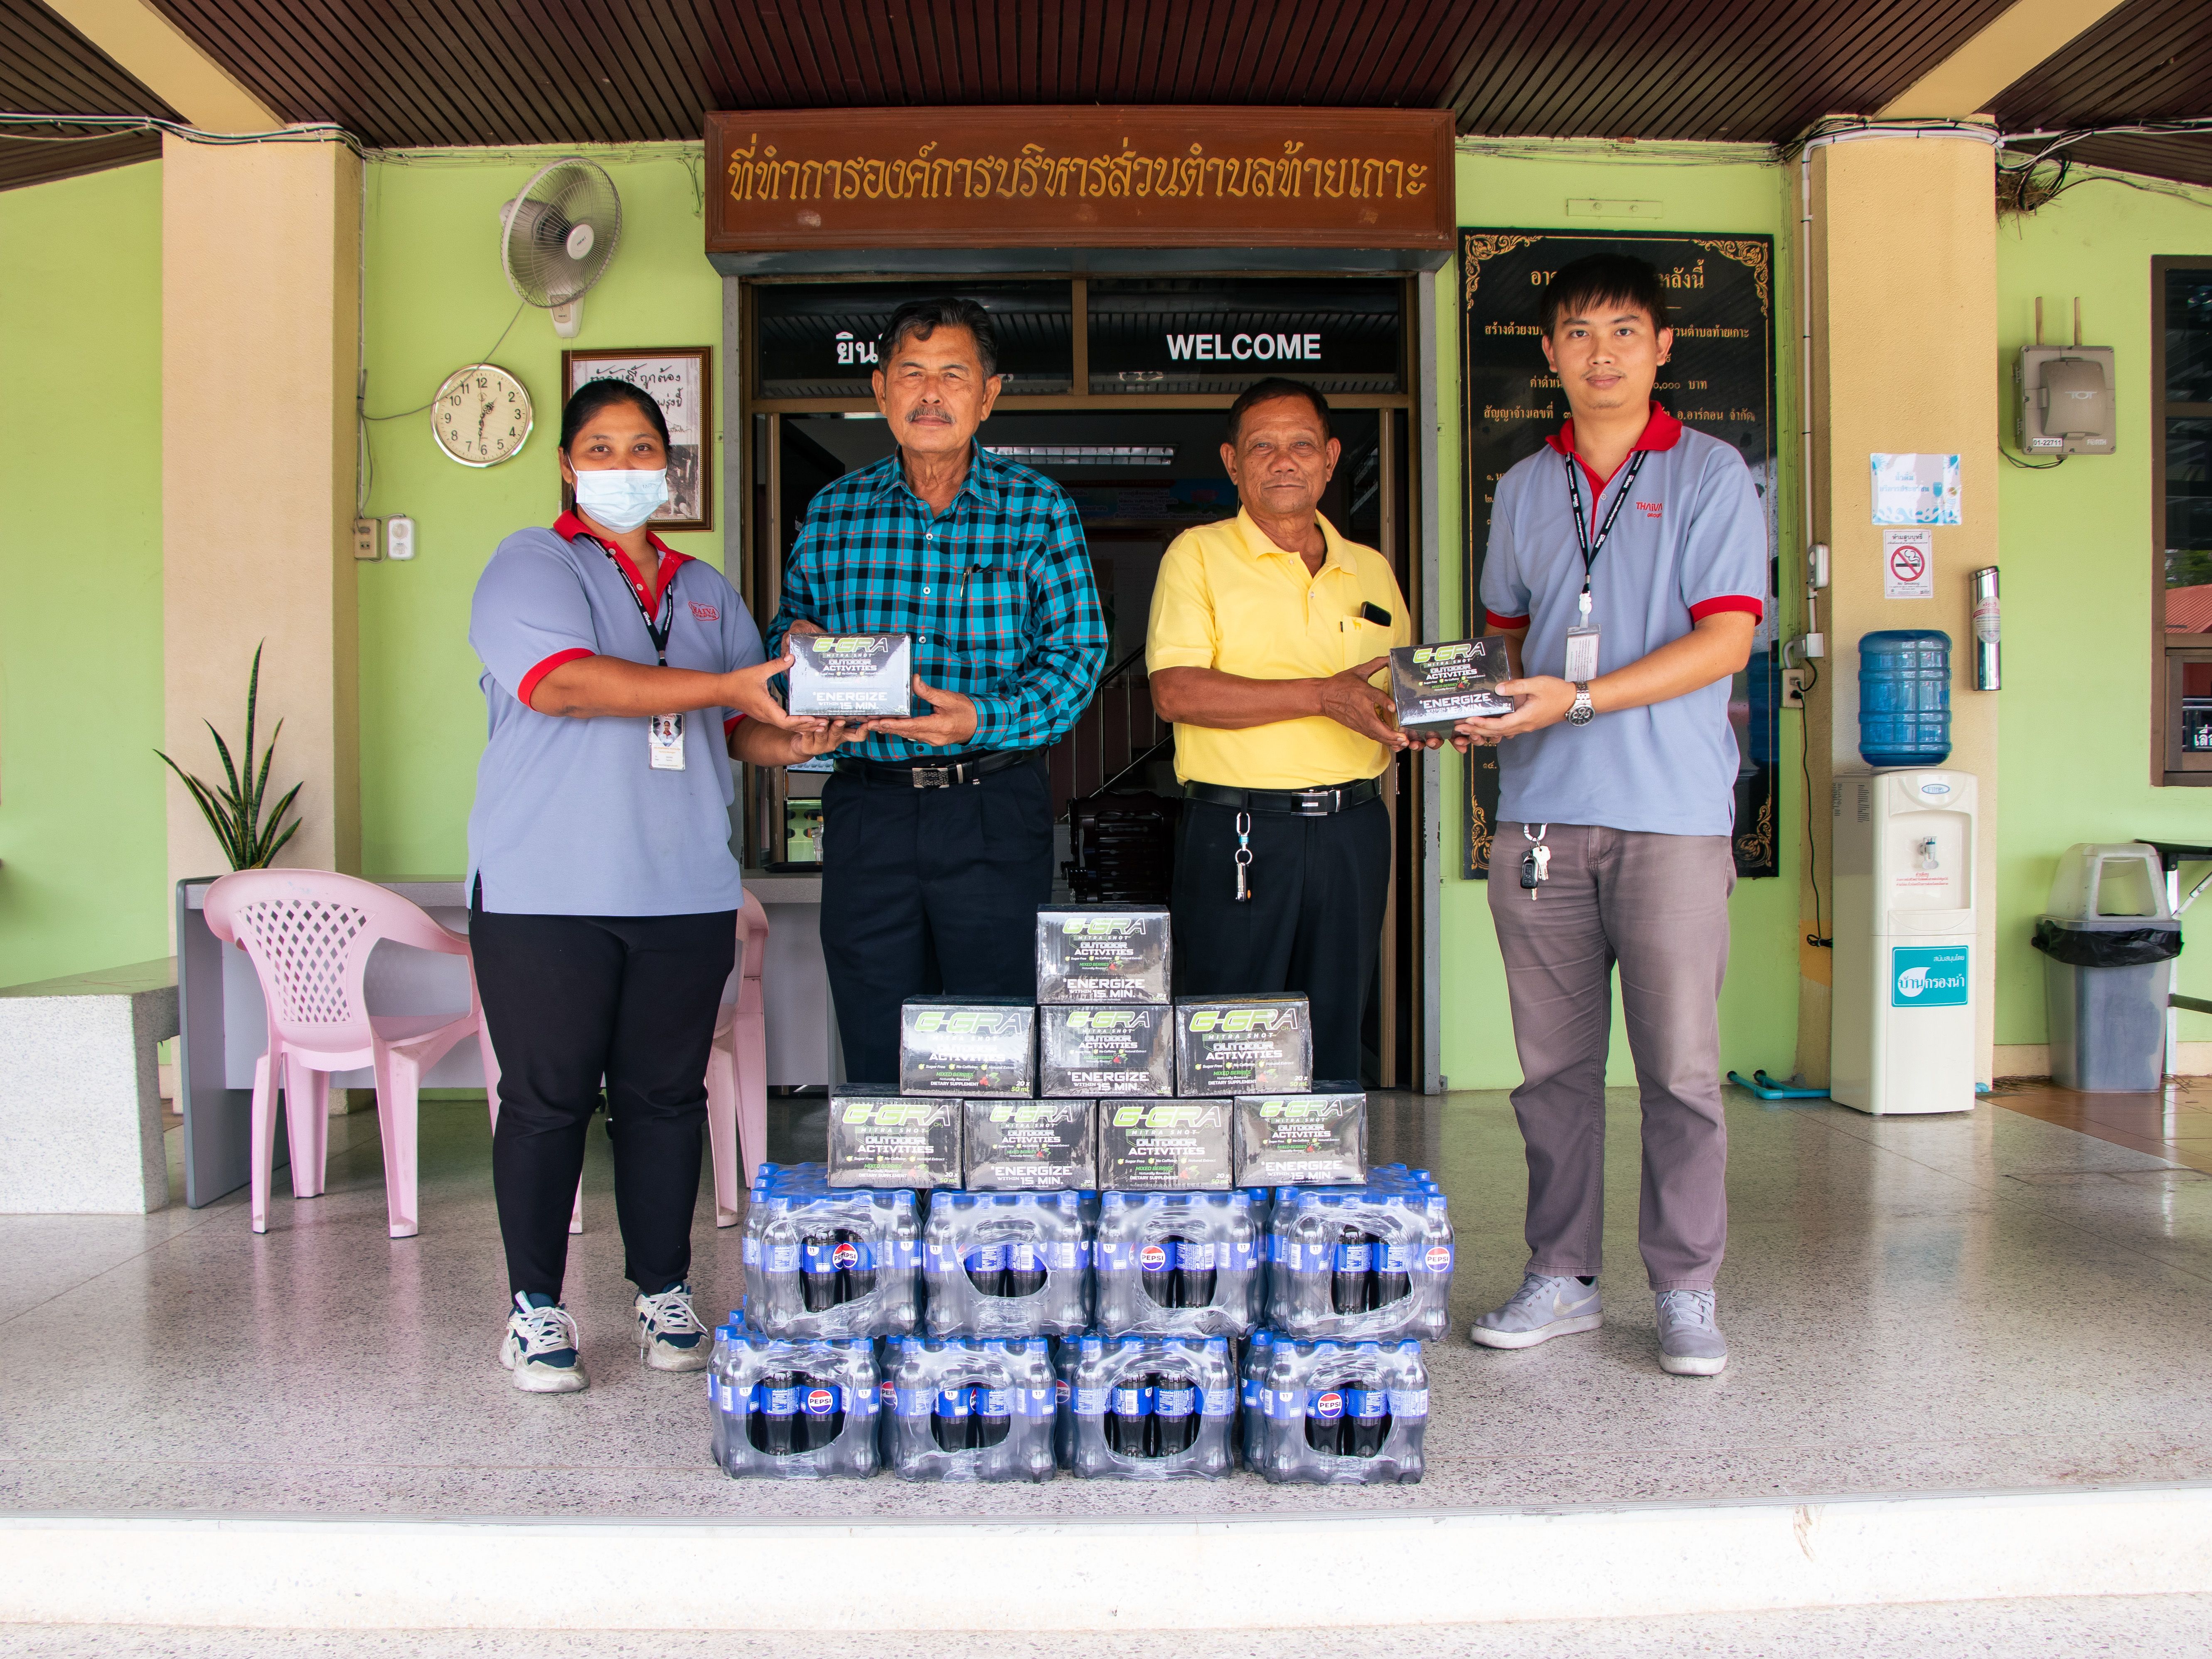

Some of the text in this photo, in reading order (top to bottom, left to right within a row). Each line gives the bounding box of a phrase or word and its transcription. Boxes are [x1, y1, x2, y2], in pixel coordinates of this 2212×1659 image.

[726, 134, 1427, 202] ที่ทำการองค์การบริหารส่วนตำบลท้ายเกาะ
[836, 331, 883, 364] ยิน
[1166, 334, 1321, 359] WELCOME
[476, 377, 487, 388] 12
[497, 382, 502, 391] 1
[1688, 380, 1708, 389] บาท
[461, 384, 469, 394] 11
[450, 396, 461, 406] 10
[508, 392, 515, 402] 2
[514, 409, 521, 419] 3
[1484, 401, 1553, 422] สัญญาจ้างเลขที่
[445, 413, 451, 423] 9
[451, 431, 458, 440] 8
[509, 427, 516, 437] 4
[466, 441, 472, 452] 7
[497, 439, 504, 450] 5
[481, 445, 487, 455] 6
[1892, 532, 1923, 542] ห้ามสูบบุหรี่
[812, 638, 888, 652] G-GRA
[1413, 642, 1486, 663] G-GRA
[1430, 664, 1471, 674] OUTDOOR
[1426, 669, 1477, 680] ACTIVITIES
[816, 692, 888, 701] ENERGIZE
[1422, 692, 1491, 709] ENERGIZE
[1062, 918, 1146, 935] G-GRA
[1933, 954, 1965, 962] สนับสนุนโดย
[1067, 978, 1145, 989] ENERGIZE
[1898, 972, 1965, 990] บ้านกรองน้ำ
[1110, 989, 1135, 998] MIN.
[914, 1012, 1022, 1034] G-GRA
[1066, 1011, 1150, 1028] G-GRA
[1189, 1008, 1298, 1032] G-GRA
[1213, 1041, 1275, 1051] OUTDOOR
[929, 1053, 1006, 1061] ACTIVITIES
[1206, 1050, 1282, 1061] ACTIVITIES
[1071, 1072, 1149, 1082] ENERGIZE
[1115, 1083, 1140, 1091] MIN.
[1260, 1100, 1343, 1117] G-GRA
[842, 1104, 950, 1126] G-GRA
[1113, 1106, 1222, 1128] G-GRA
[865, 1136, 927, 1145] OUTDOOR
[1136, 1138, 1197, 1147] OUTDOOR
[857, 1145, 934, 1153] ACTIVITIES
[1128, 1147, 1205, 1155] ACTIVITIES
[995, 1166, 1073, 1176] ENERGIZE
[1265, 1160, 1343, 1172] ENERGIZE
